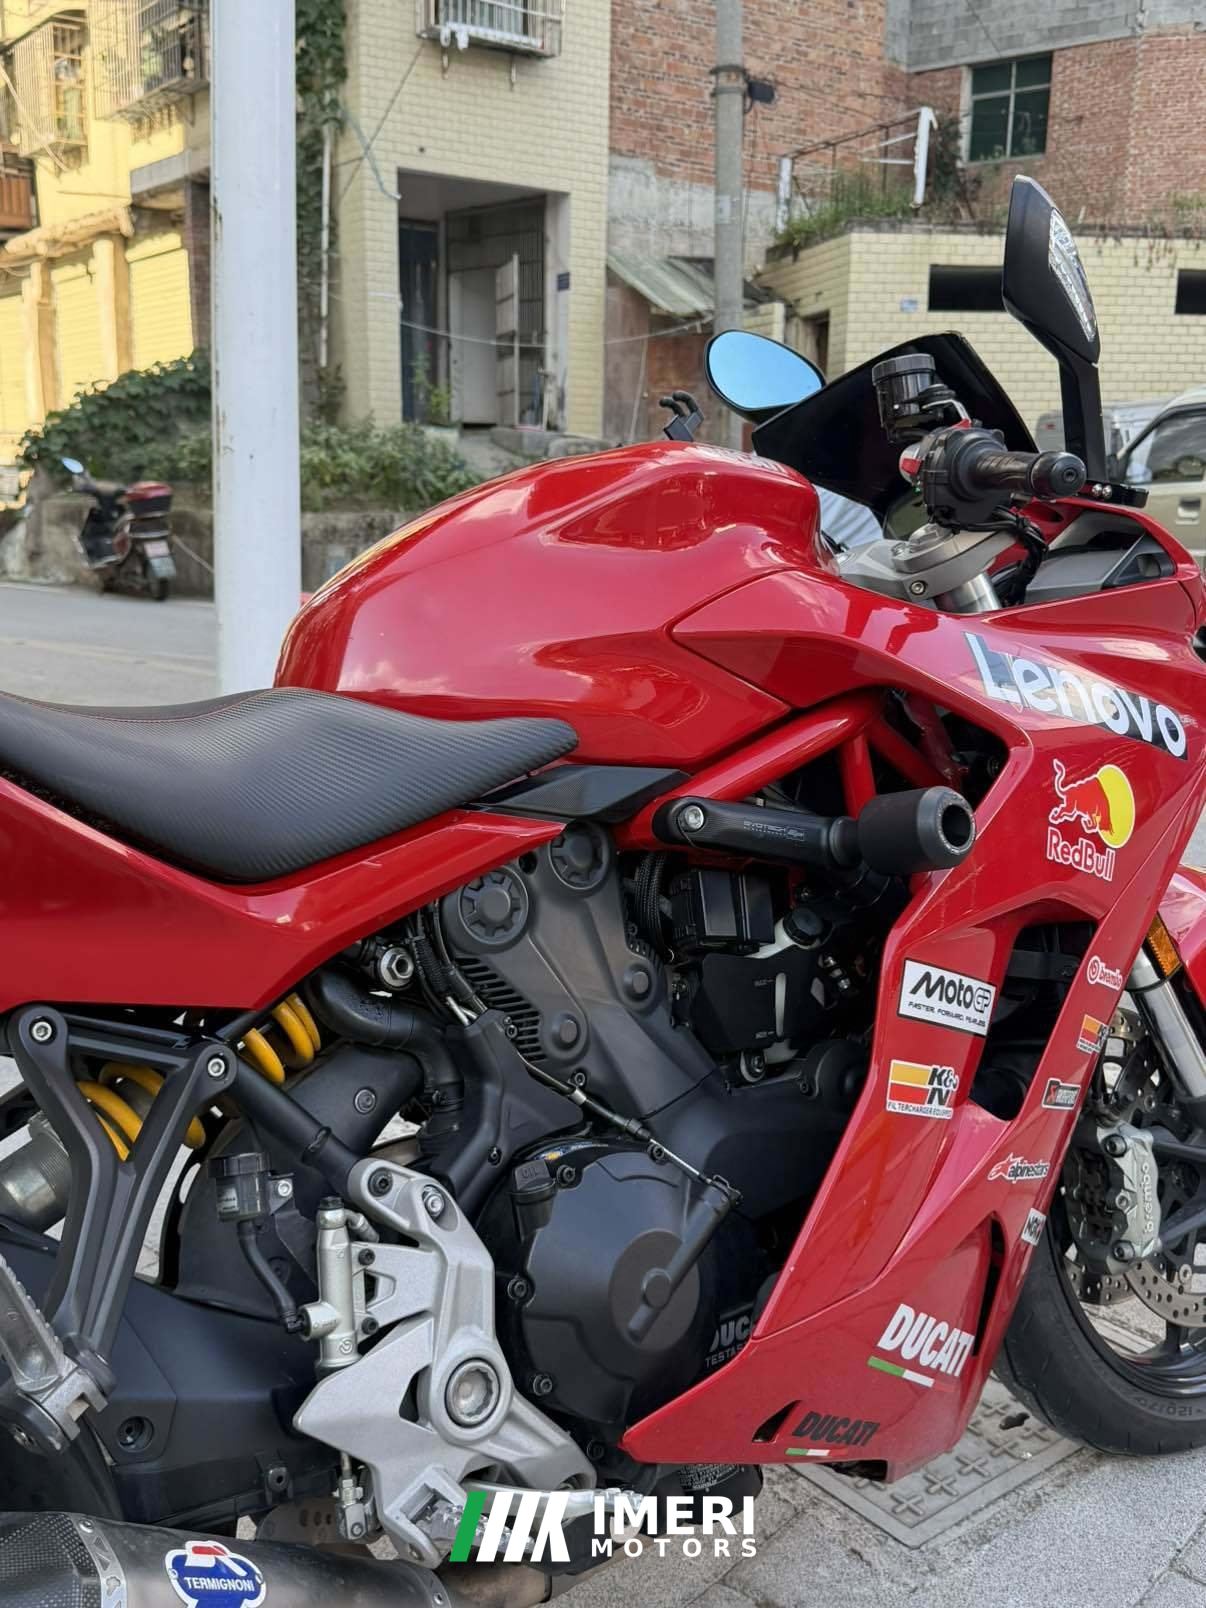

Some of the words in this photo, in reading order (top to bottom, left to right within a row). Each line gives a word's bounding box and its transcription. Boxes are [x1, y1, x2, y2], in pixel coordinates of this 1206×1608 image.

[965, 632, 1187, 757] Lenovo
[1141, 1162, 1154, 1233] brembo
[877, 1303, 975, 1377] DUCATI
[792, 1411, 880, 1446] DUCATI
[184, 1577, 255, 1592] TERMIGNONI
